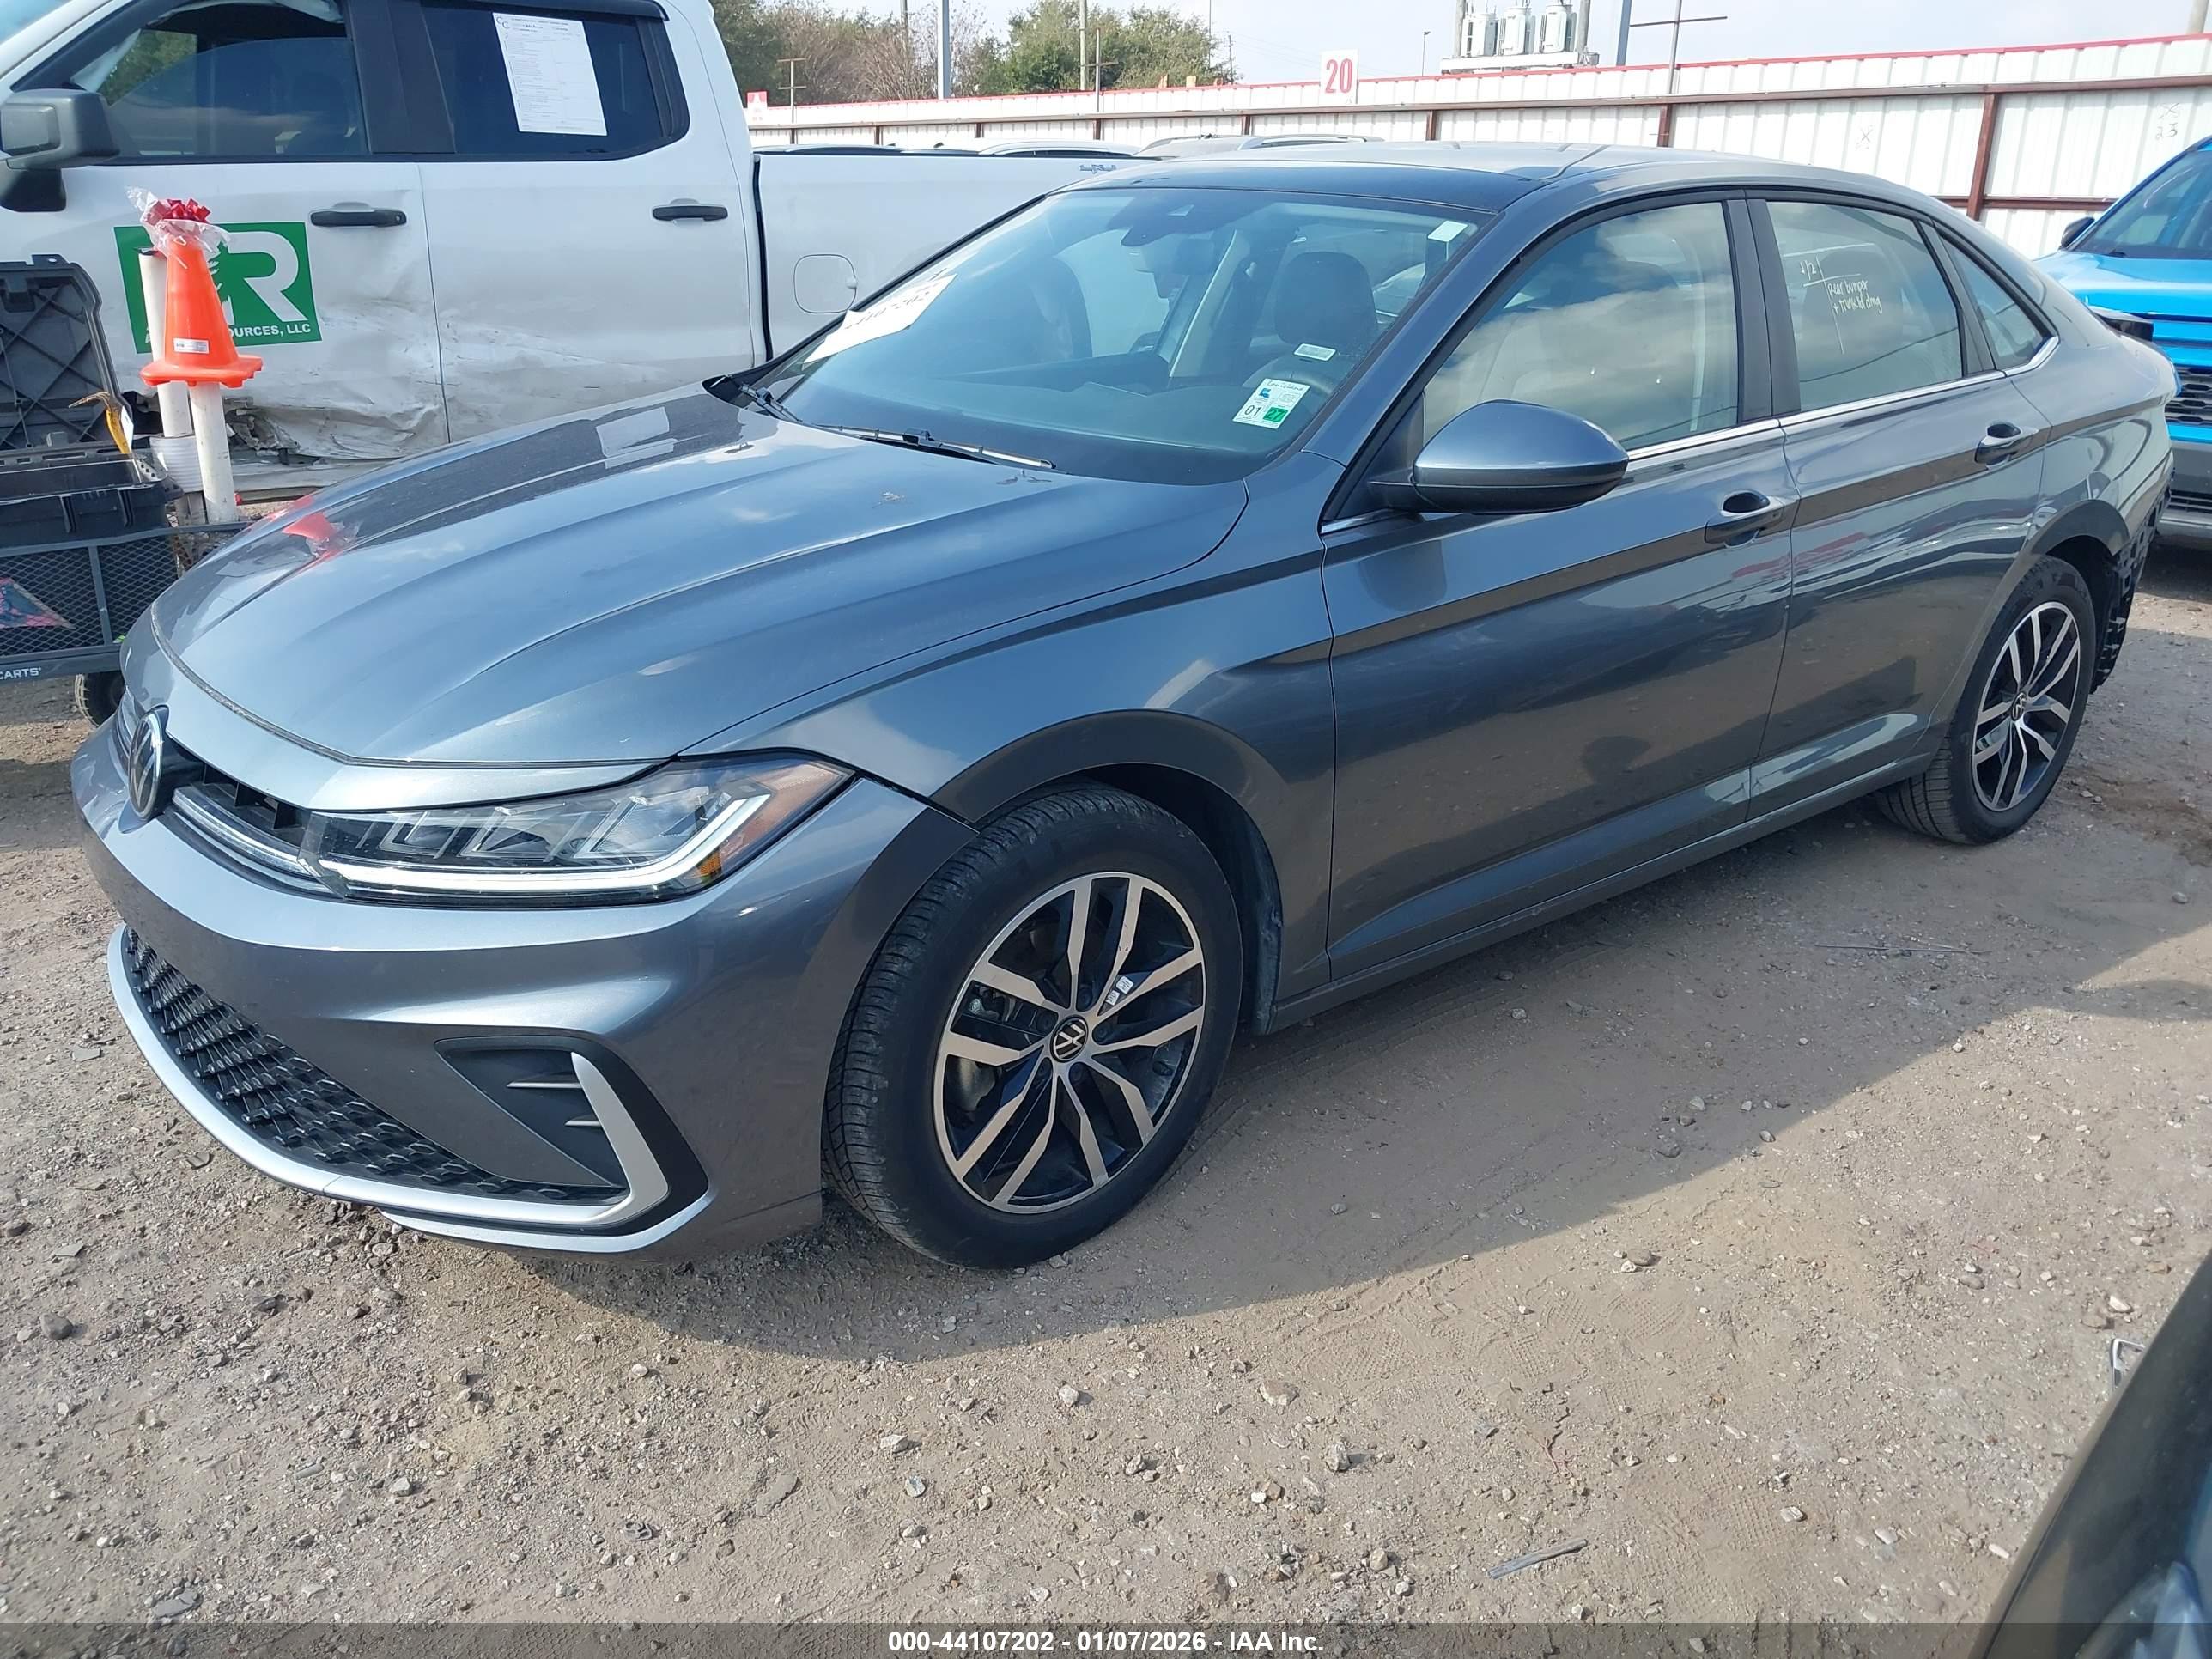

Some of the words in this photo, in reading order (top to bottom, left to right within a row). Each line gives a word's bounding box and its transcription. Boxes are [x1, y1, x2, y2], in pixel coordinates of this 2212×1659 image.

[1325, 58, 1352, 94] 20
[287, 323, 311, 335] LLC
[1244, 404, 1262, 416] 01
[1266, 408, 1286, 421] 27
